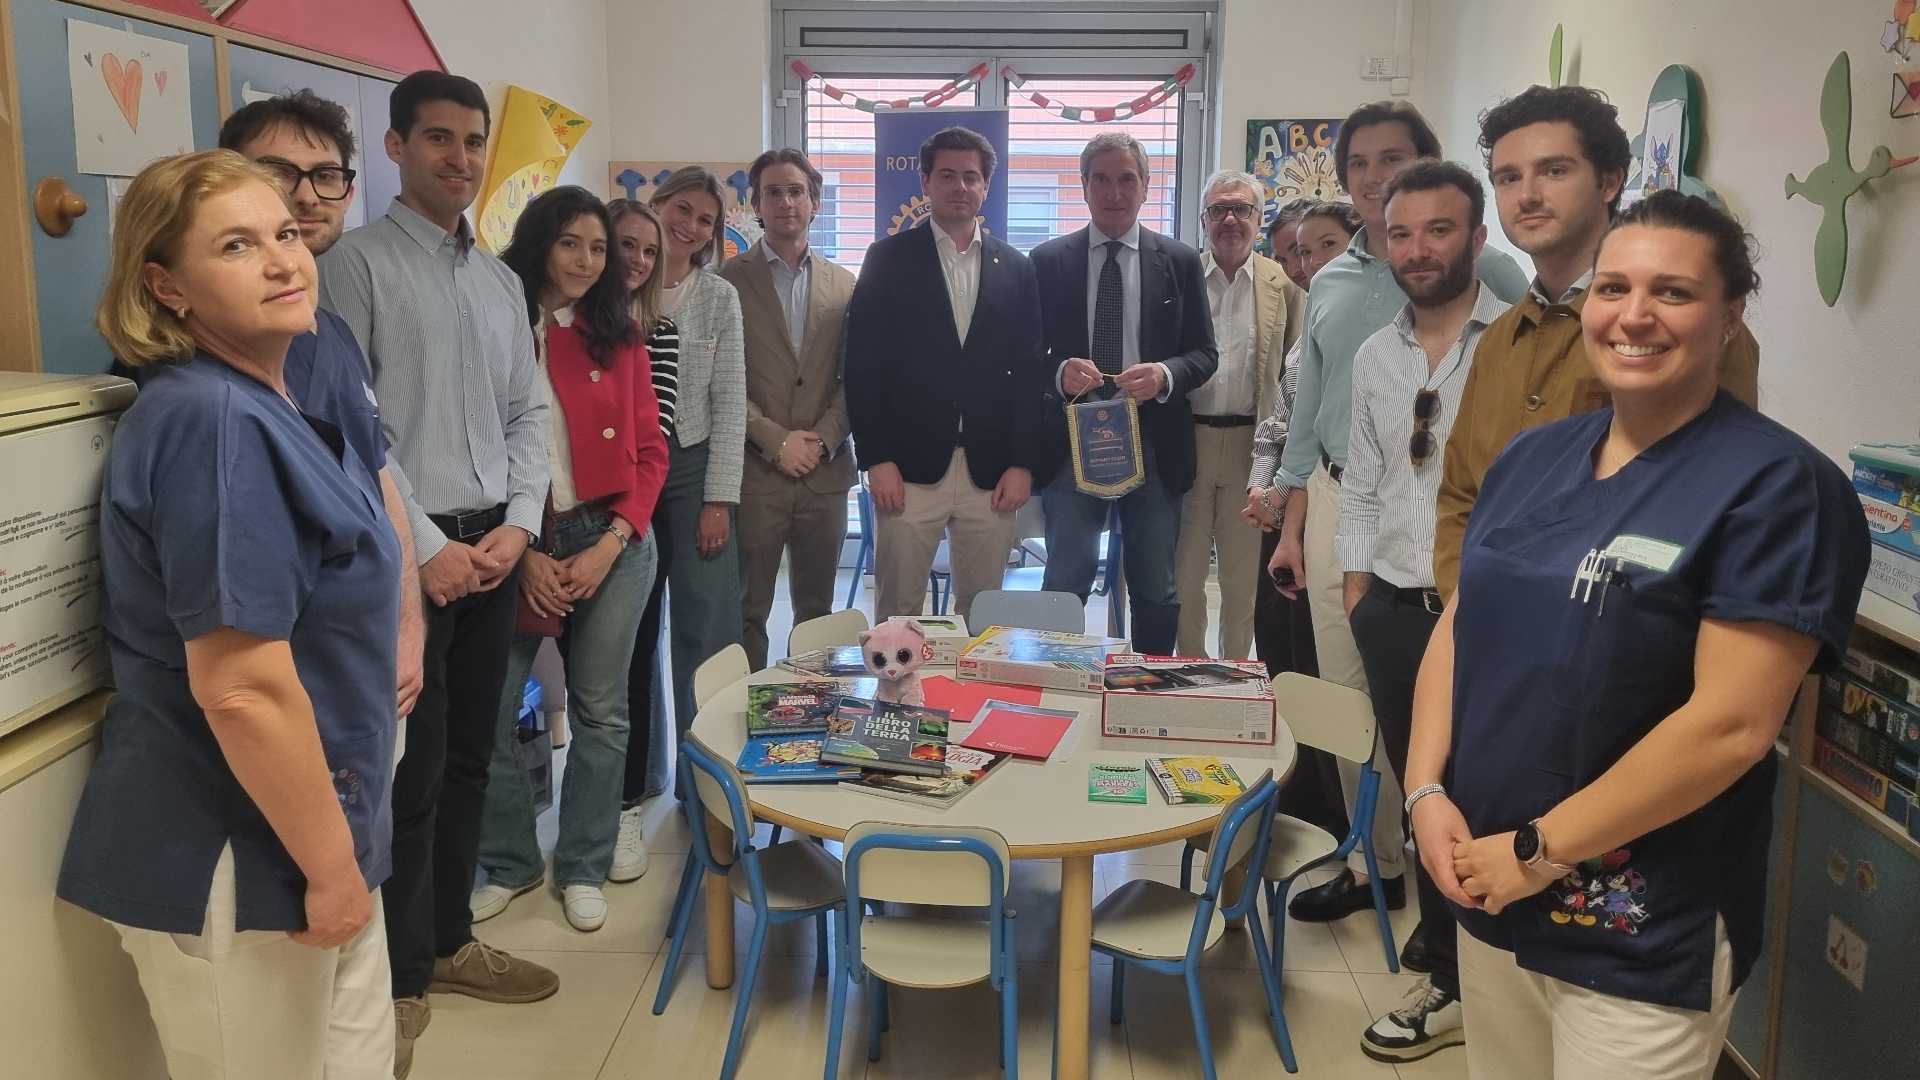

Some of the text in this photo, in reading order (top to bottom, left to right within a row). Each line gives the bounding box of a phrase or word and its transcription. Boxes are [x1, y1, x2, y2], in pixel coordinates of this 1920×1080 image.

[1313, 150, 1327, 176] 12
[867, 715, 912, 728] LIBRO
[884, 711, 898, 720] IL
[863, 728, 910, 742] TERRA
[865, 721, 911, 735] DELLA
[948, 752, 982, 766] OGIA
